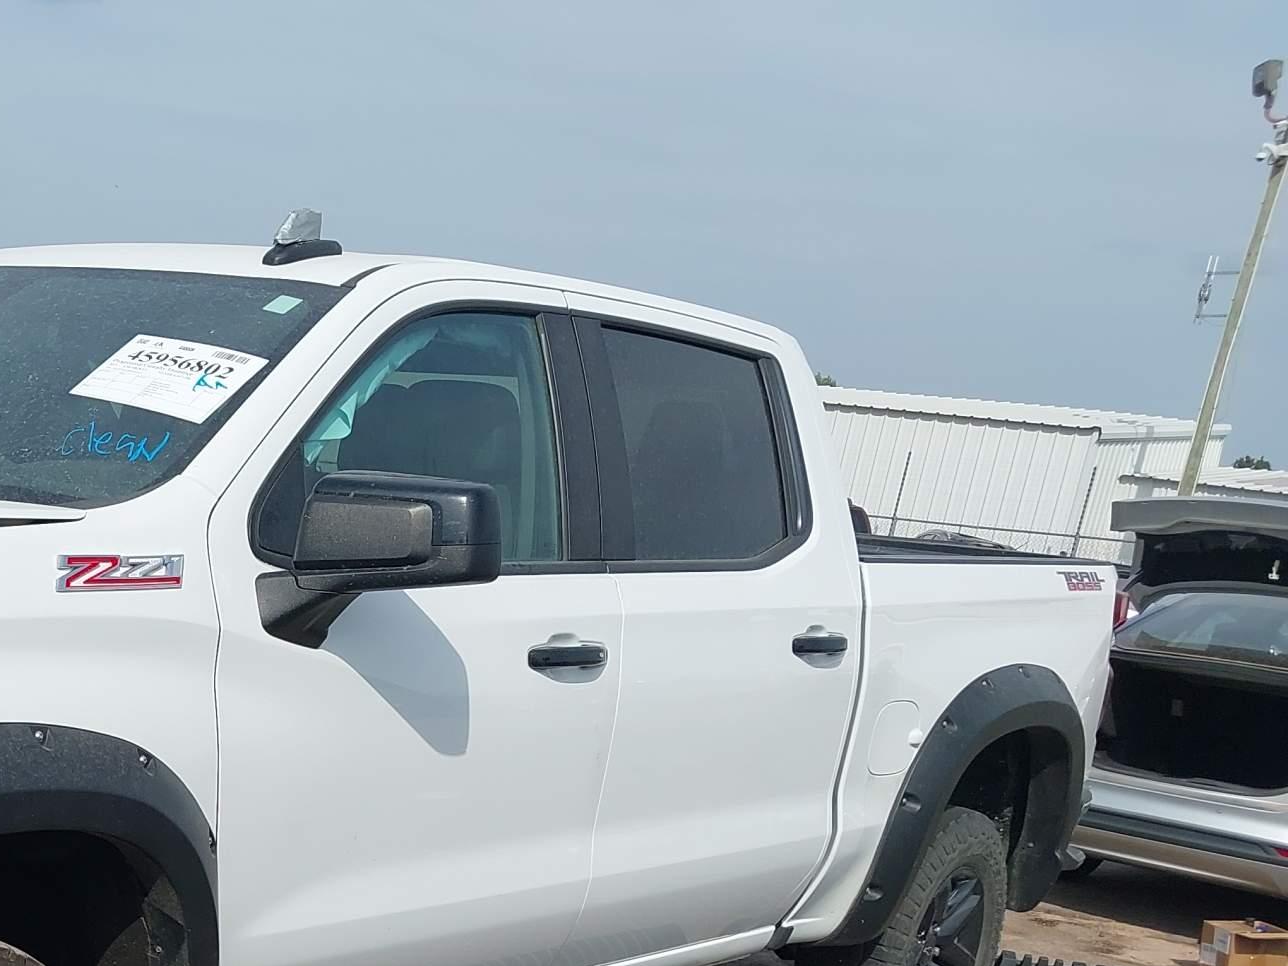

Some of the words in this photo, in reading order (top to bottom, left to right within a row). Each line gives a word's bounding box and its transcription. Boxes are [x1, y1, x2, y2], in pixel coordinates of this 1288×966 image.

[127, 349, 235, 380] 45956802
[55, 554, 185, 593] Z71
[1056, 571, 1106, 583] TRAIL
[1066, 582, 1103, 592] BOSS
